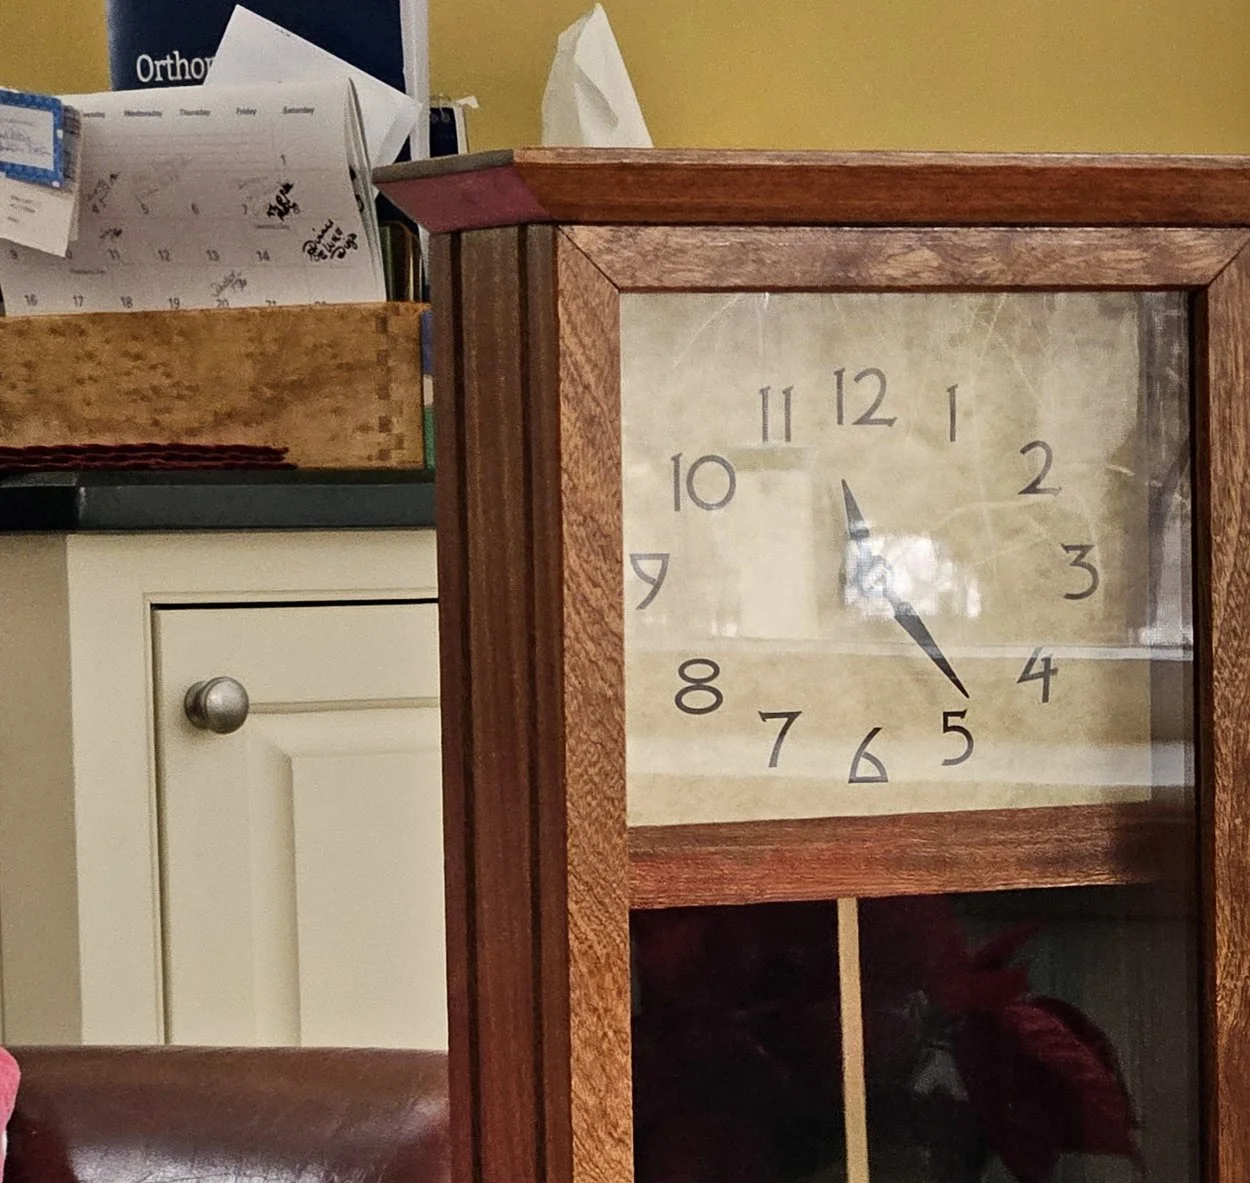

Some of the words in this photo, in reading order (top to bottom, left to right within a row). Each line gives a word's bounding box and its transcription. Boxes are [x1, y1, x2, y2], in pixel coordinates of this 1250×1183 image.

[235, 106, 257, 116] Friday
[157, 248, 171, 262] 12
[206, 250, 220, 262] 13
[256, 250, 270, 262] 14
[24, 294, 38, 307] 16
[72, 294, 85, 307] 17
[120, 295, 134, 309] 18
[168, 296, 181, 310] 19
[759, 385, 794, 442] 11
[834, 368, 897, 428] 12
[946, 384, 958, 442] 1
[671, 453, 737, 512] 10
[1018, 440, 1062, 496] 2
[629, 553, 671, 610] 9
[1061, 544, 1099, 600] 3
[675, 658, 724, 716] 8
[1017, 646, 1058, 704] 4
[758, 710, 803, 768] 7
[848, 727, 889, 784] 6
[941, 709, 974, 766] 5
